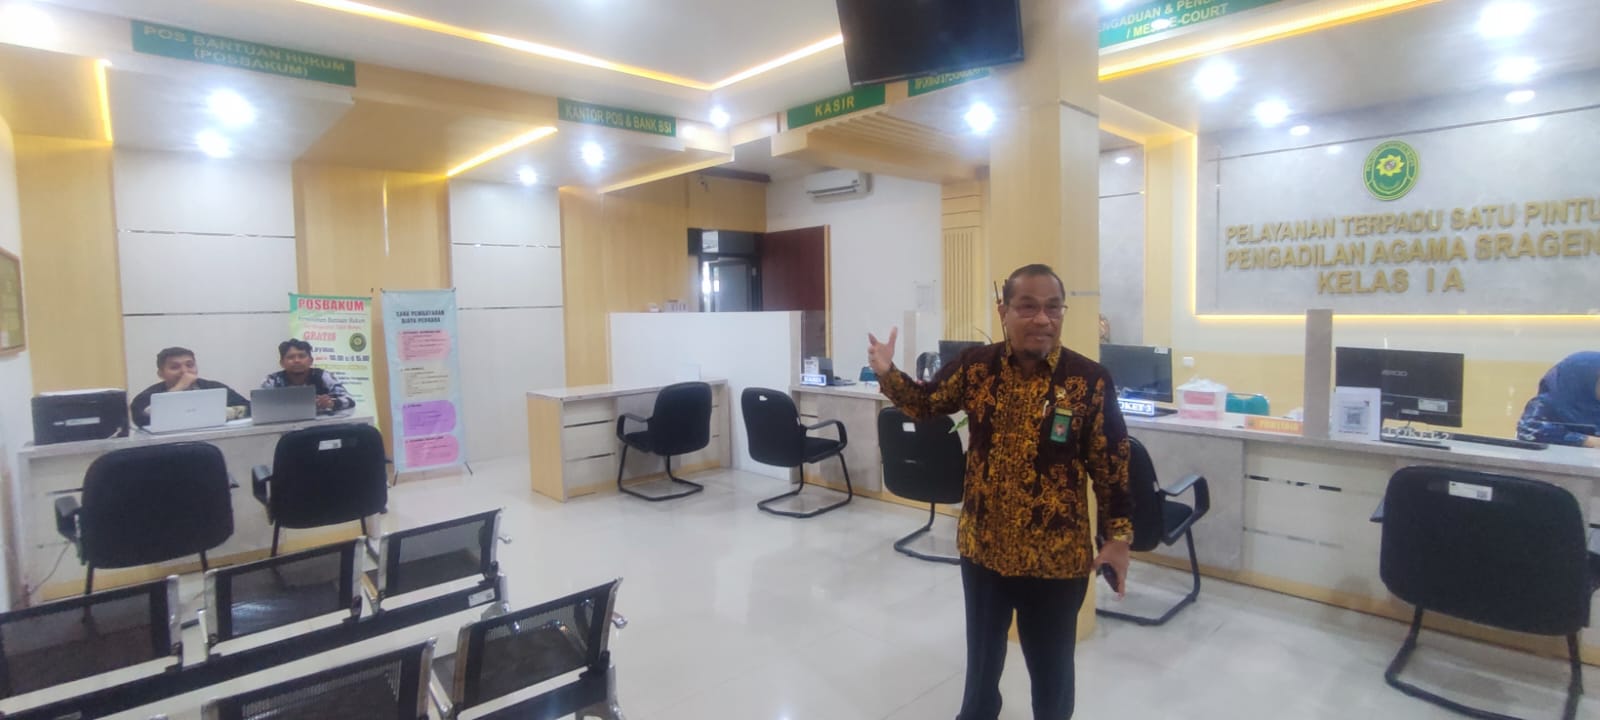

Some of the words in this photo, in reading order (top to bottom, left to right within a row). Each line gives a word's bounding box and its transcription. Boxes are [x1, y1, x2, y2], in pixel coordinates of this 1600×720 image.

[1164, 4, 1173, 15] &
[1169, 3, 1229, 28] E-COURT
[143, 25, 187, 43] POS
[192, 36, 281, 61] BANTUAN
[286, 53, 345, 72] HUKUM
[193, 49, 309, 77] (POSBAKUM)
[565, 104, 603, 122] KANTOR
[605, 111, 624, 126] POS
[625, 114, 632, 128] &
[633, 116, 657, 131] BANK
[659, 121, 672, 133] BSI
[815, 95, 855, 117] KASIR
[1225, 217, 1336, 245] PELAYANAN
[1341, 210, 1443, 239] TERPADU
[1451, 203, 1514, 231] SATU
[1525, 197, 1600, 226] PINTU
[1225, 240, 1365, 270] PENGADILAN
[1371, 236, 1468, 265] AGAMA
[1475, 228, 1600, 262] SRAGEN
[1317, 268, 1409, 295] KELAS
[1426, 268, 1434, 293] I
[1444, 267, 1465, 293] A
[298, 298, 364, 311] POSBAKUM
[1118, 401, 1144, 411] OKET
